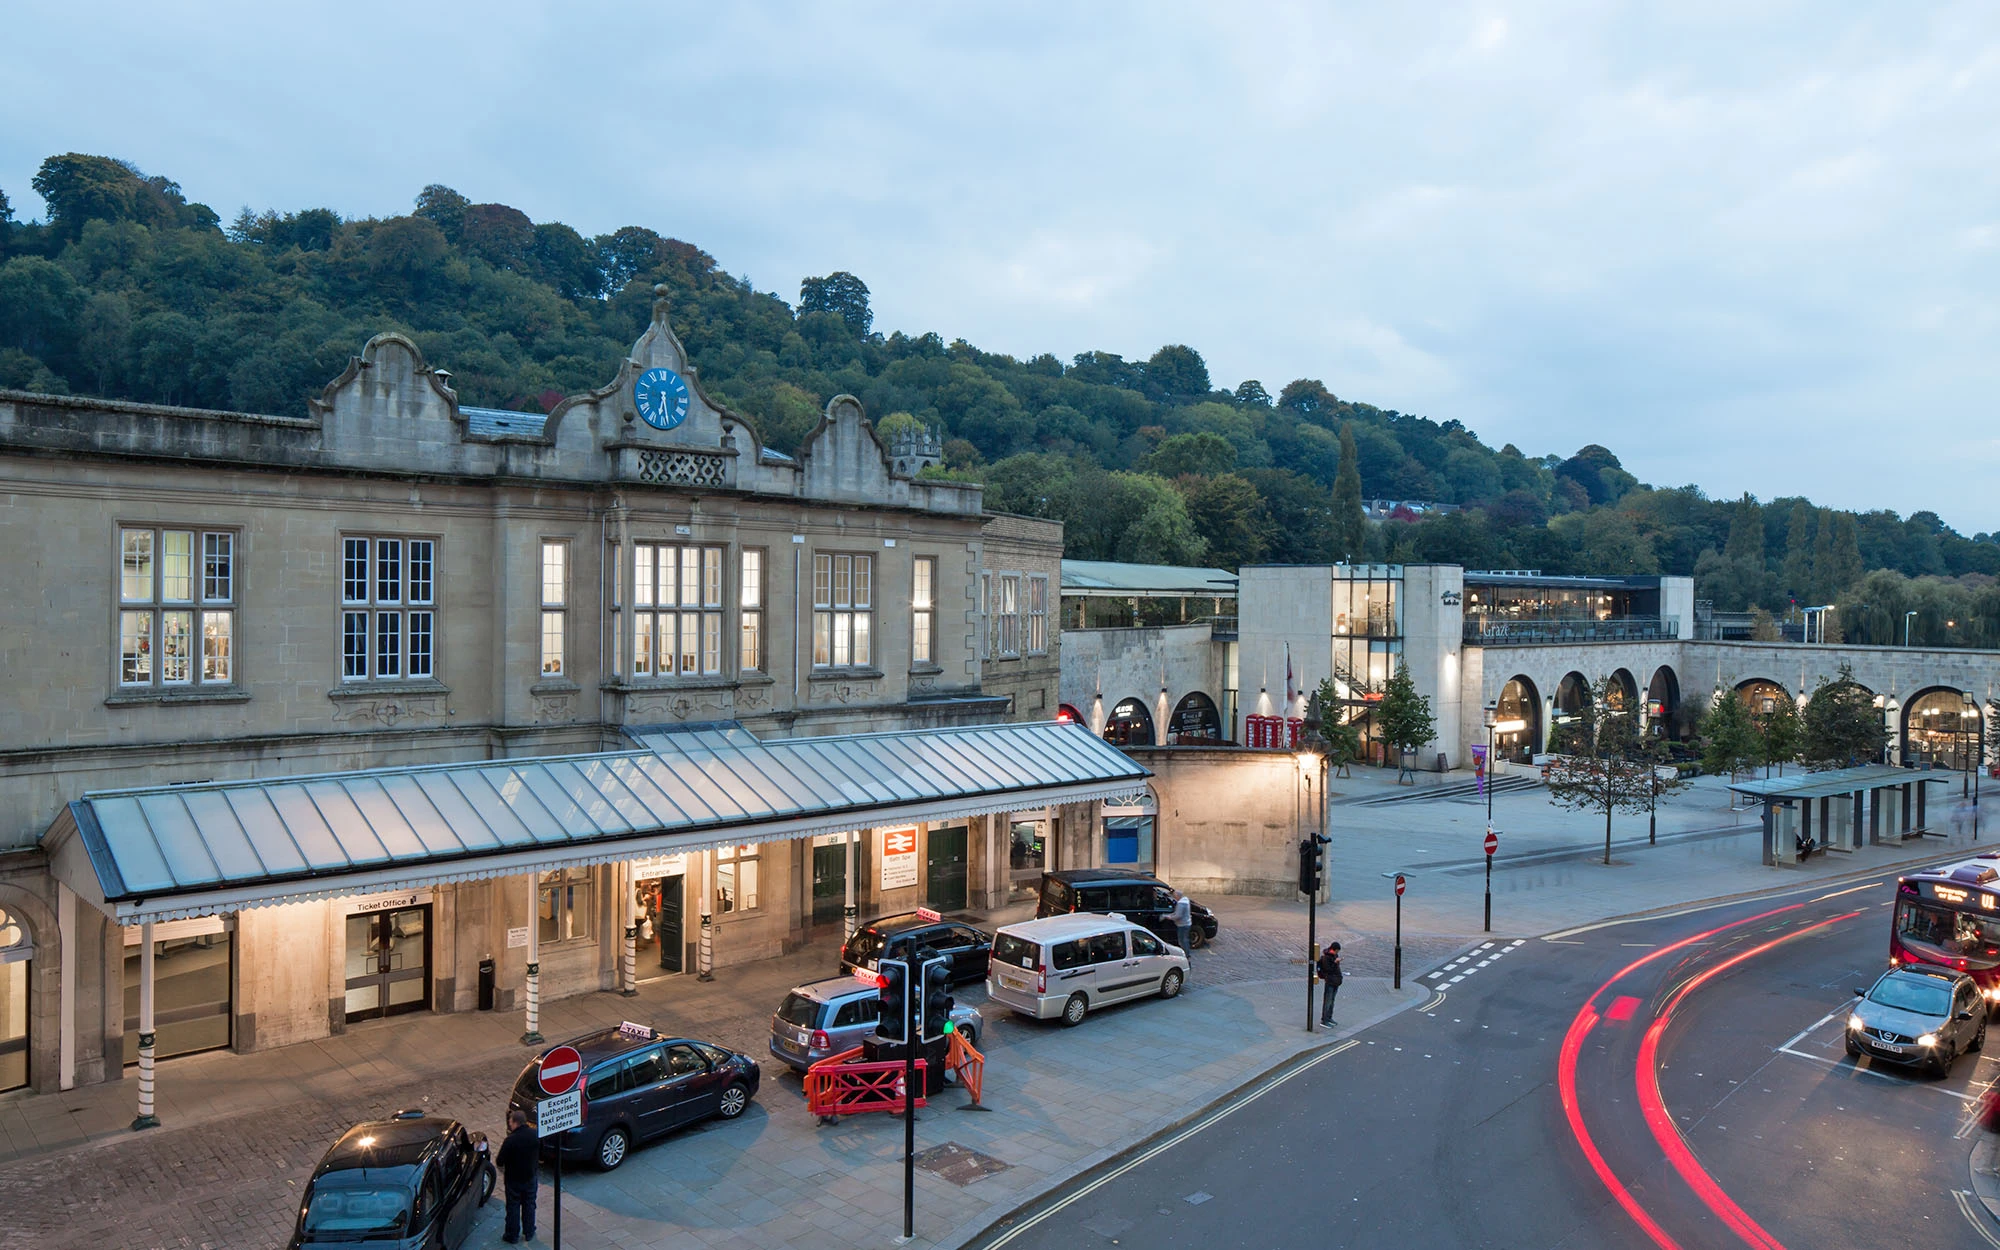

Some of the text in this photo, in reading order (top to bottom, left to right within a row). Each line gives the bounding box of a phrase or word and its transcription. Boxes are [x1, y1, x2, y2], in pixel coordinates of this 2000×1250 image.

[1483, 621, 1509, 636] Graze
[642, 869, 670, 877] Entrance
[358, 899, 406, 911] Ticket Office
[1981, 894, 1995, 909] U1
[861, 971, 874, 980] TAXI
[627, 1027, 645, 1036] TAXI
[548, 1096, 572, 1108] Except
[541, 1101, 578, 1118] authorised
[540, 1110, 579, 1126] taxi permit
[547, 1120, 573, 1132] holders
